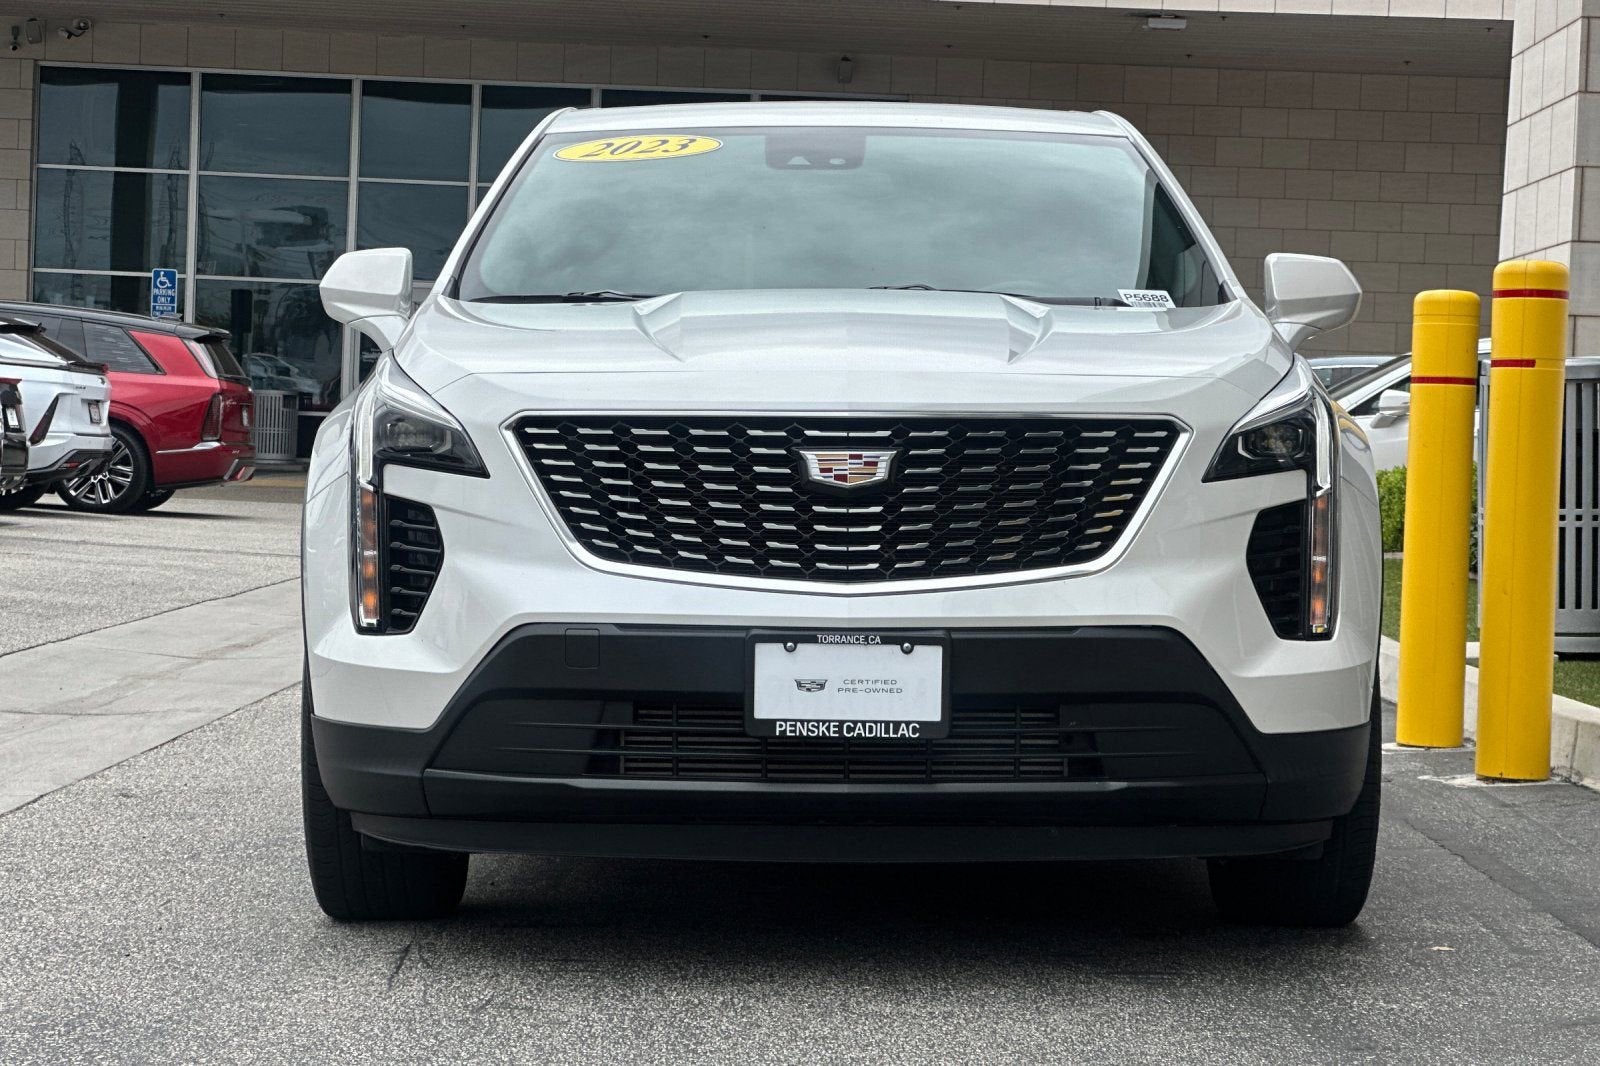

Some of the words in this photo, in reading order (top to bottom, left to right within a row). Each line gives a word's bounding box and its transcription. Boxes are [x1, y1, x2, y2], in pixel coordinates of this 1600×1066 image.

[578, 138, 697, 158] 2023
[153, 288, 176, 297] PARKING
[157, 296, 171, 304] ONLY
[1123, 293, 1169, 303] P5688
[816, 634, 868, 645] TORRANCE,
[868, 635, 882, 645] CA
[775, 721, 839, 737] PENSKE
[843, 722, 920, 738] CADILLAC
